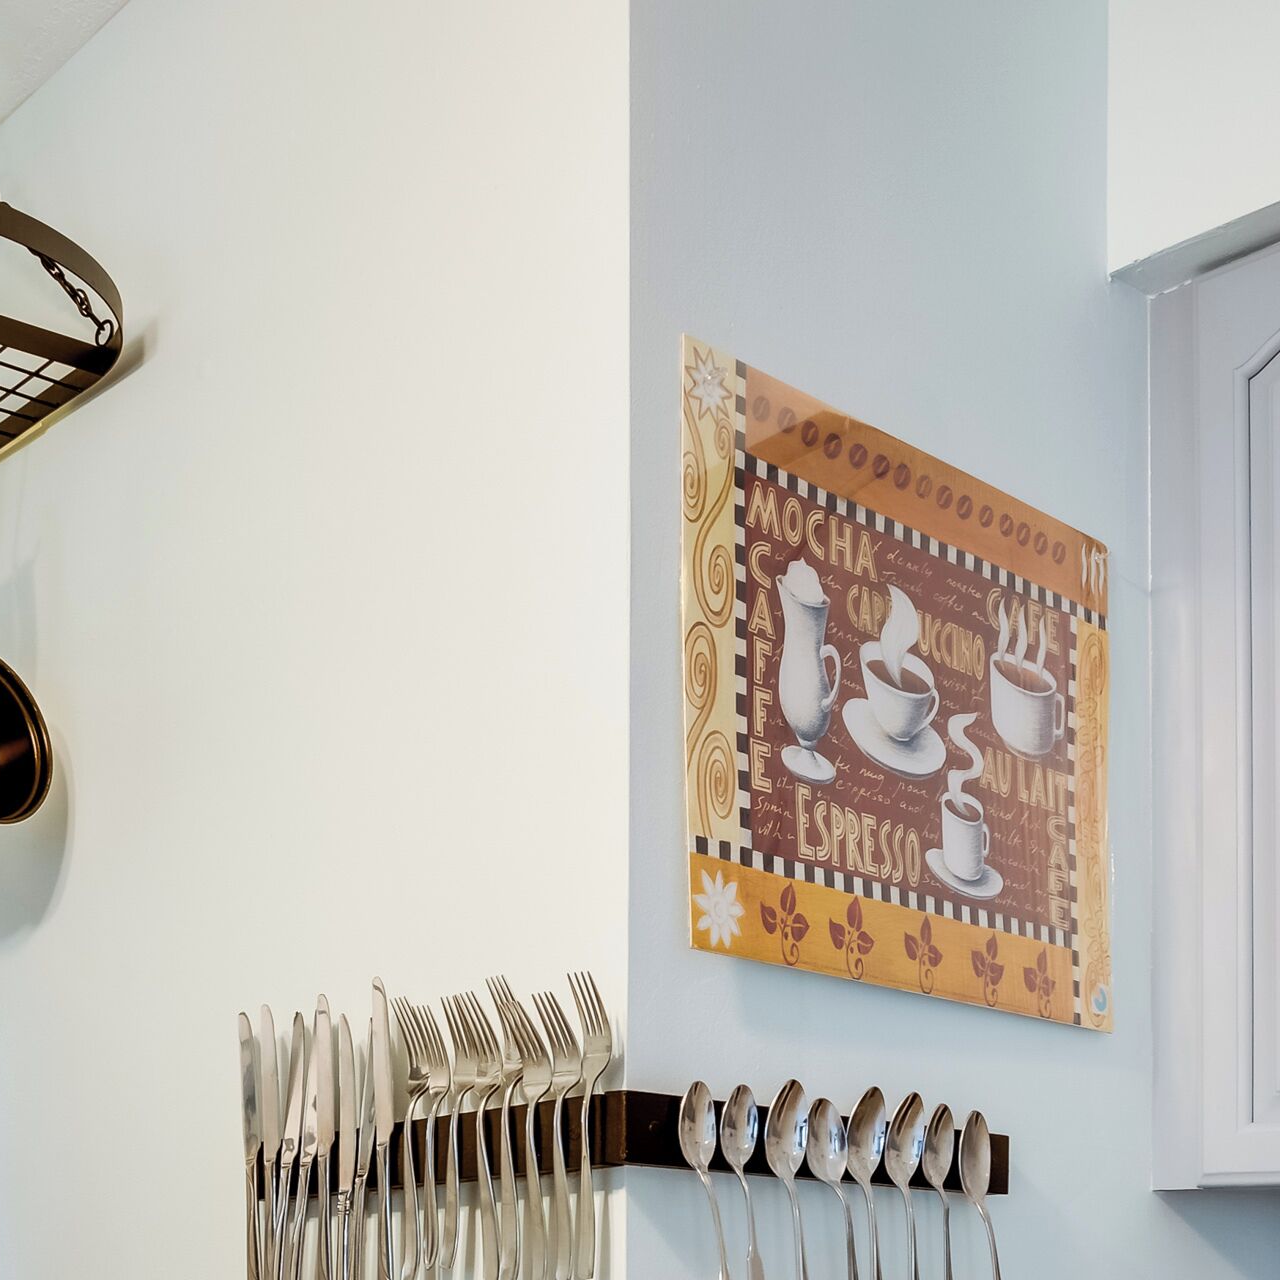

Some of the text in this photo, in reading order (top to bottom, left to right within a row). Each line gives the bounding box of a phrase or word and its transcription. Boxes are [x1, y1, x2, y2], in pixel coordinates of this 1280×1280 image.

[746, 481, 878, 582] MOCHA
[748, 541, 776, 793] CAFFE
[847, 584, 985, 681] CAPUCCINO
[986, 588, 1060, 656] CAFE
[979, 746, 1012, 798] AU
[1017, 759, 1068, 815] LAIT
[795, 782, 921, 887] ESPRESSO
[1047, 815, 1069, 931] CAFE
